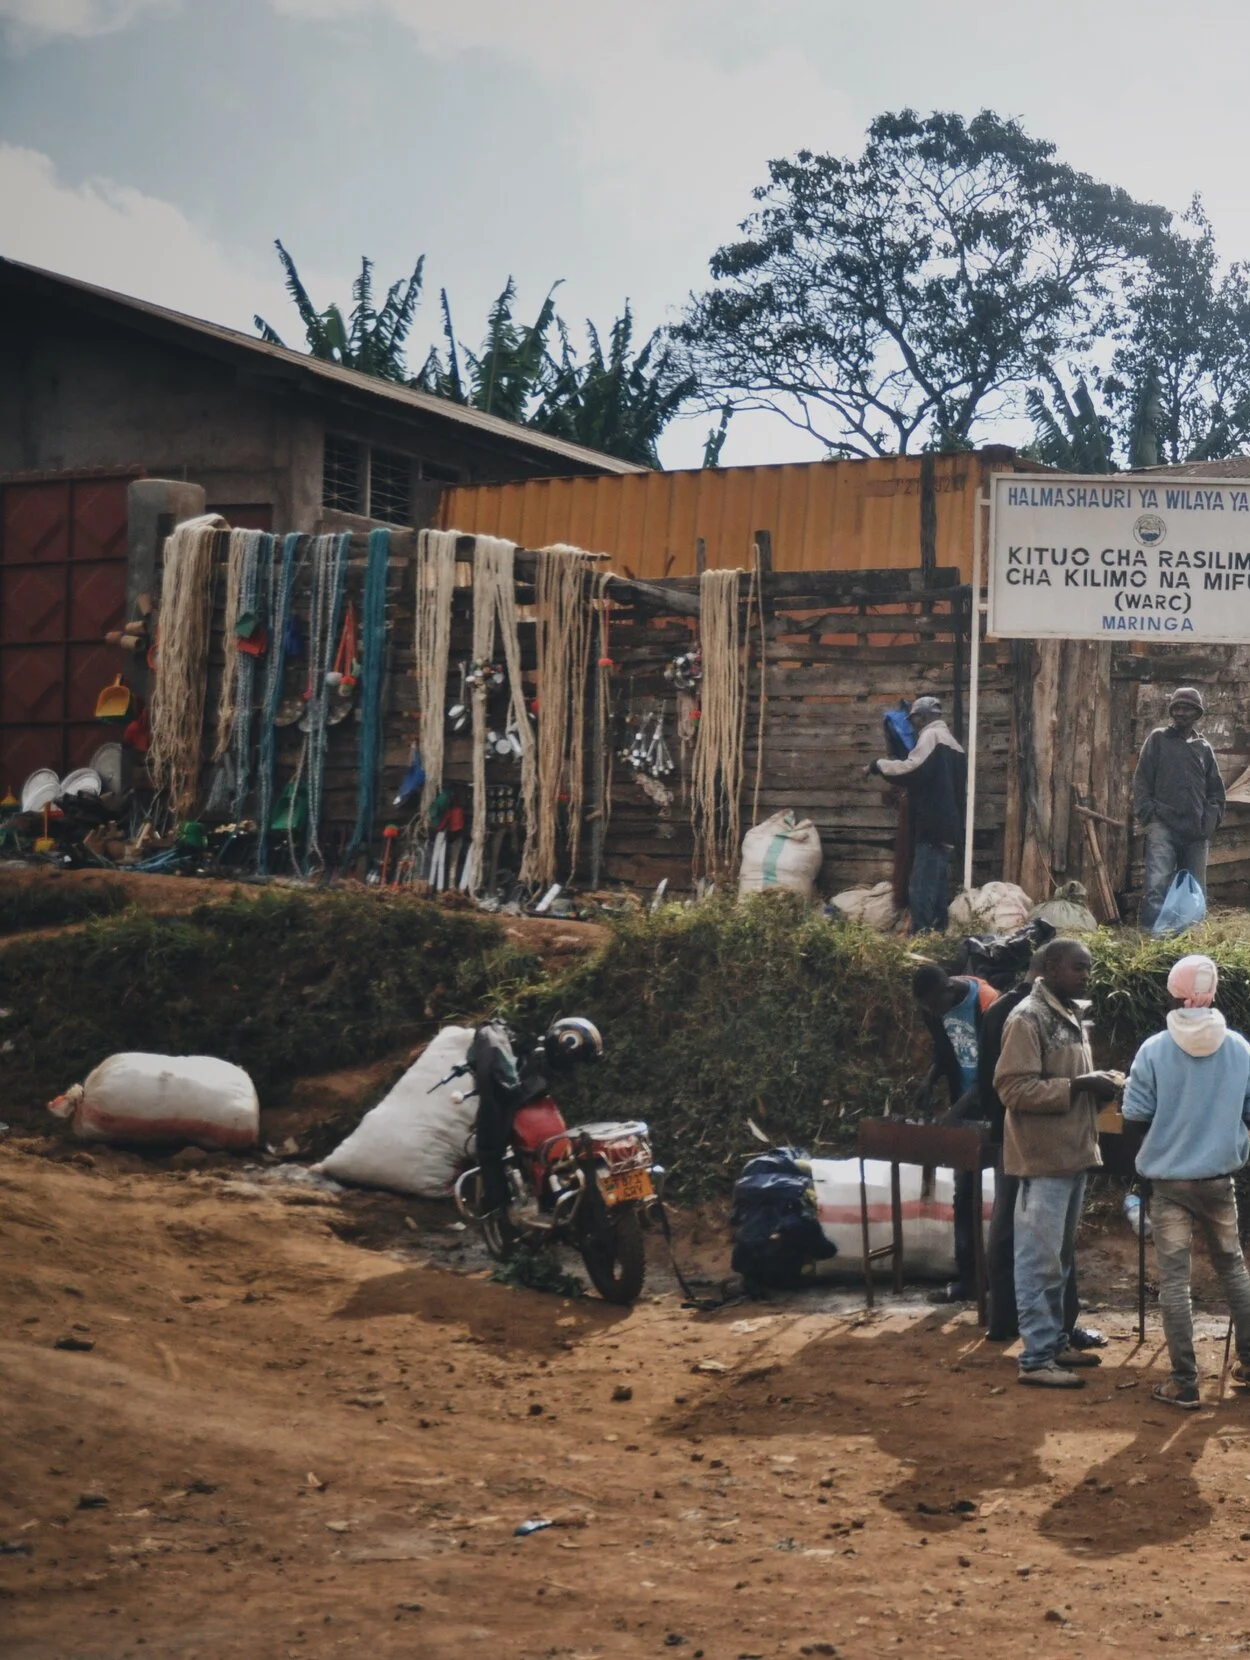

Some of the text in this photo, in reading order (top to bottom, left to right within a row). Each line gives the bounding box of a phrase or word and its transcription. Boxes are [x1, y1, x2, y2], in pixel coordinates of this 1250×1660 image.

[1008, 487, 1131, 508] HALMASHAURI
[1138, 489, 1159, 508] YA
[1166, 490, 1224, 511] WILAYA
[1229, 491, 1249, 512] YA
[1008, 547, 1089, 566] KITUO
[1101, 549, 1147, 567] CHA
[1006, 568, 1051, 586] CHA
[1065, 568, 1147, 588] KILIMO
[1160, 571, 1191, 589] NA
[1114, 591, 1192, 614] (WARC)
[1102, 615, 1194, 632] MARINGA
